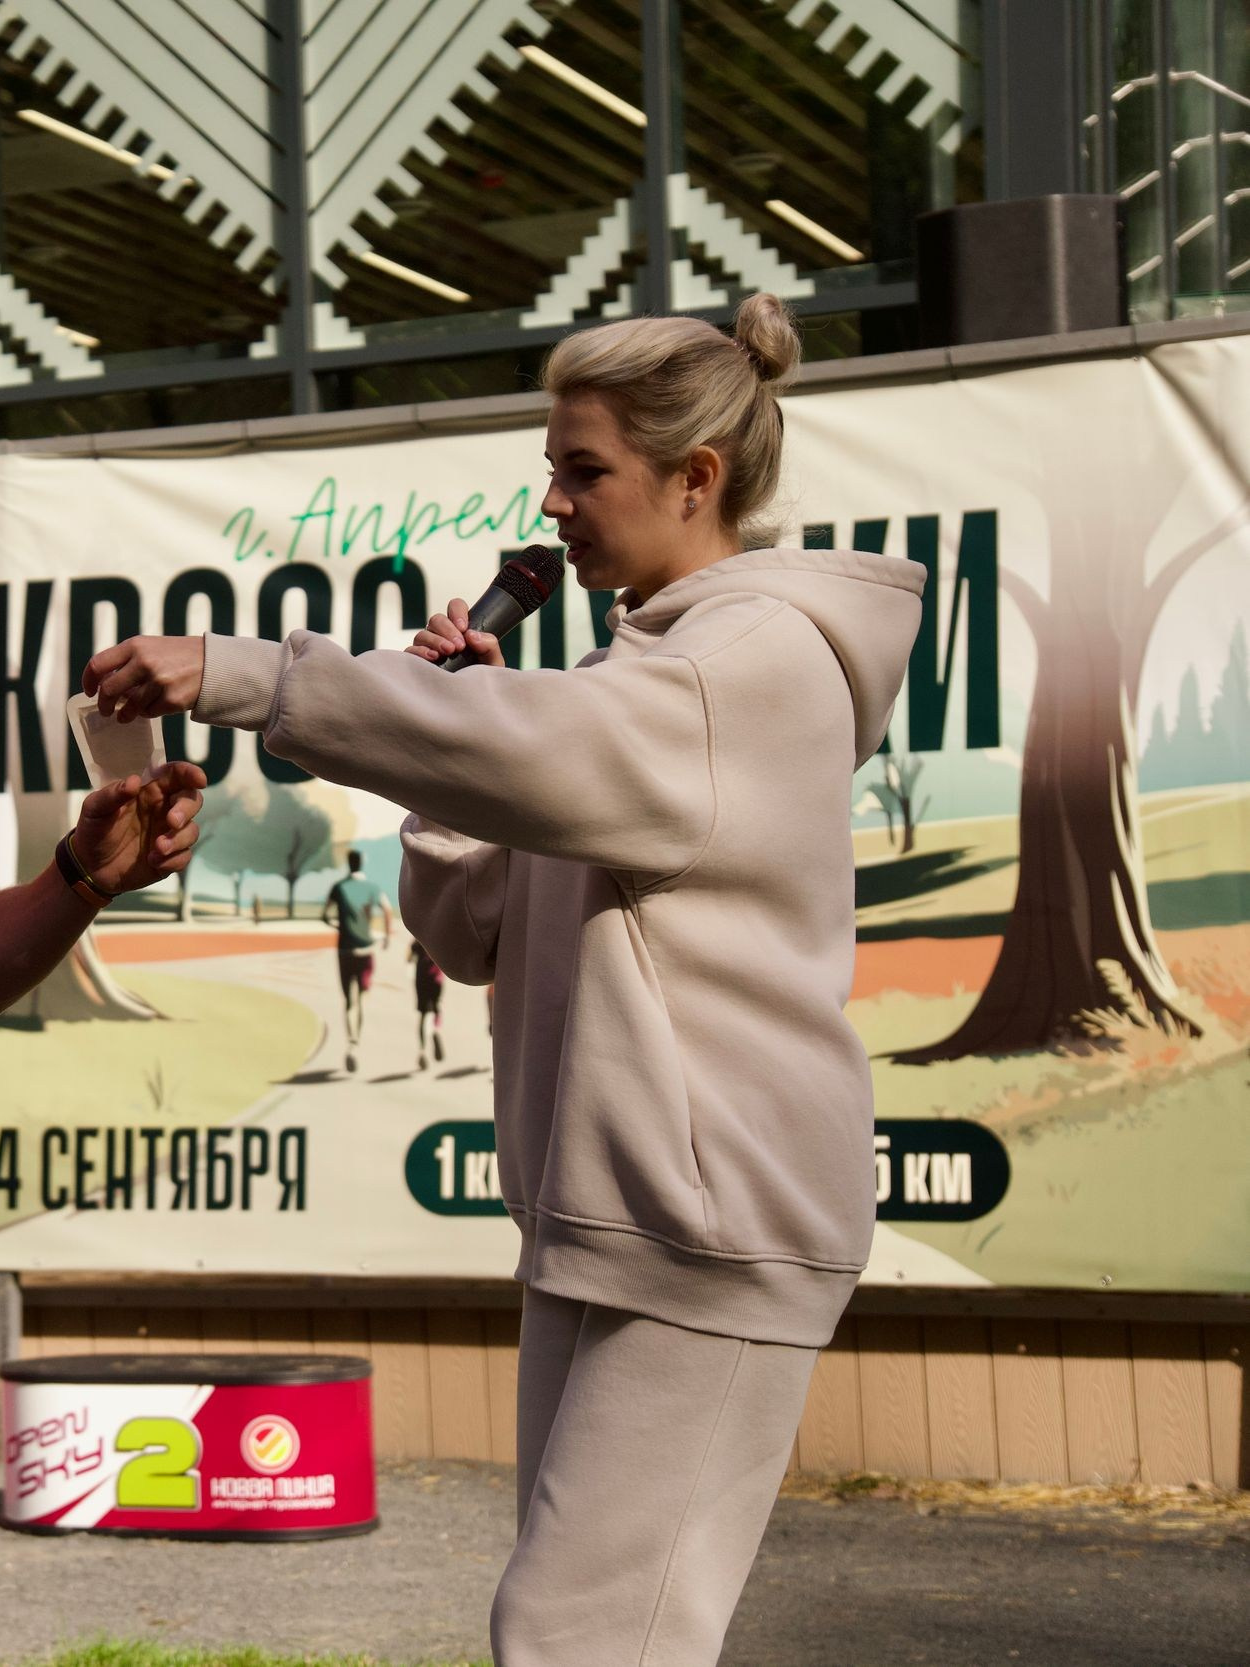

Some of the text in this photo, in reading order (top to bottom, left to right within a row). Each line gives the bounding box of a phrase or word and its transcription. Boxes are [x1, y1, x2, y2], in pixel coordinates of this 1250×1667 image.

[40, 1126, 308, 1211] СЕНТЯБРЯ
[434, 1134, 455, 1200] 1
[115, 1416, 202, 1512] 2
